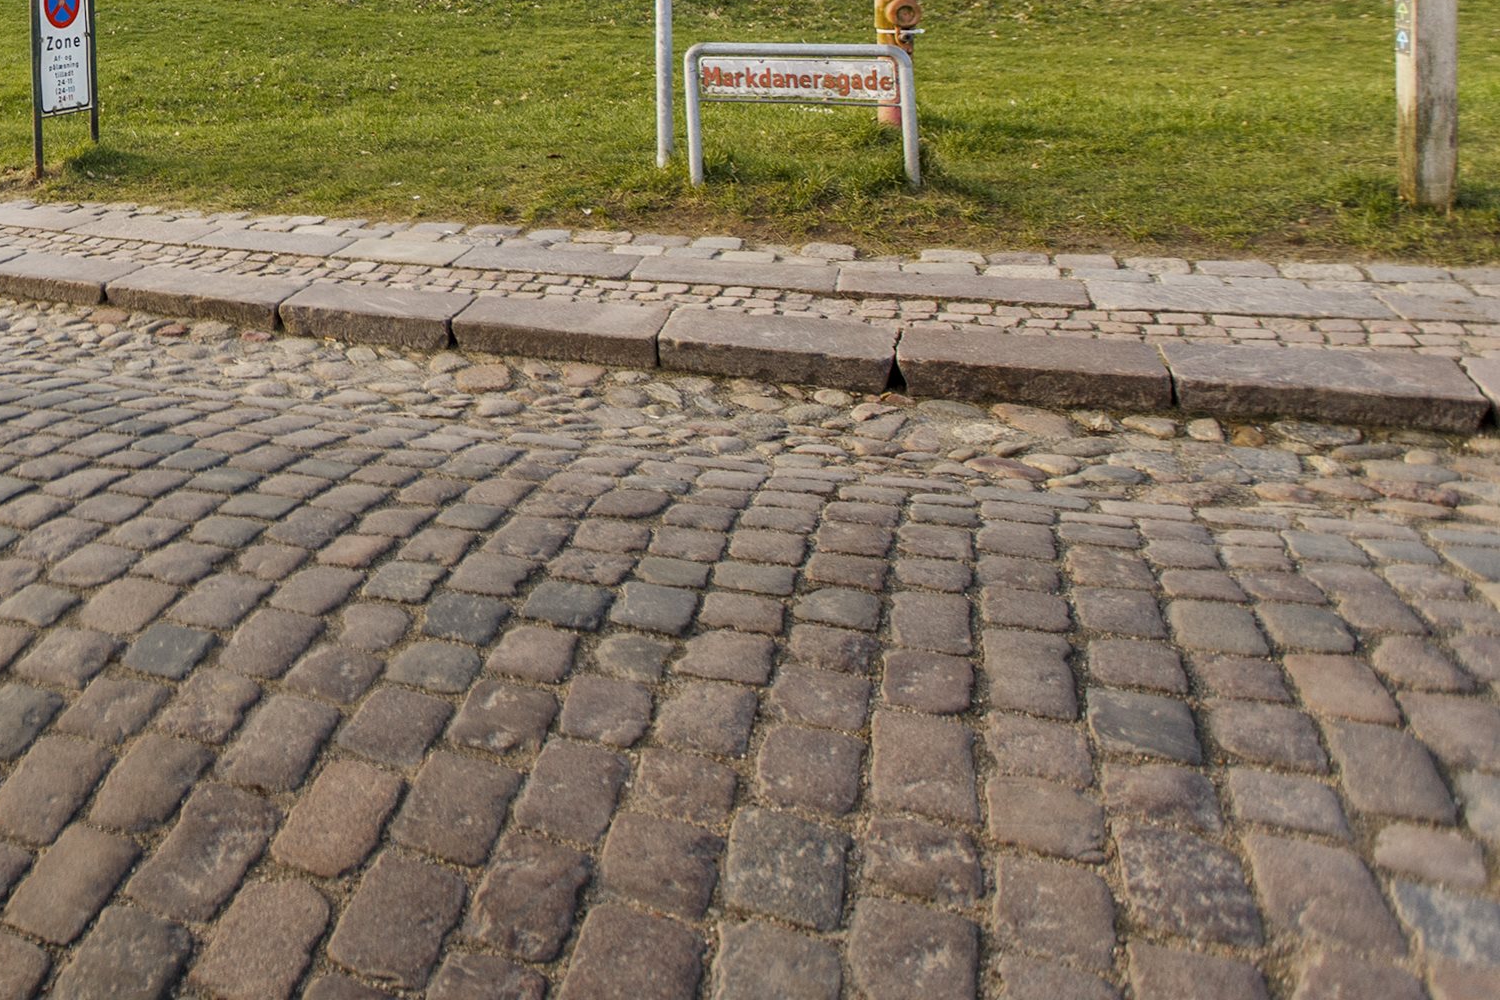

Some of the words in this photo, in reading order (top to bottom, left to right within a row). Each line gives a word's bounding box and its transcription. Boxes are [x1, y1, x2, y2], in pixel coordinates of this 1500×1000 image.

[46, 36, 80, 51] Zone
[55, 70, 74, 78] tilladt
[702, 66, 894, 97] Markdanersgade
